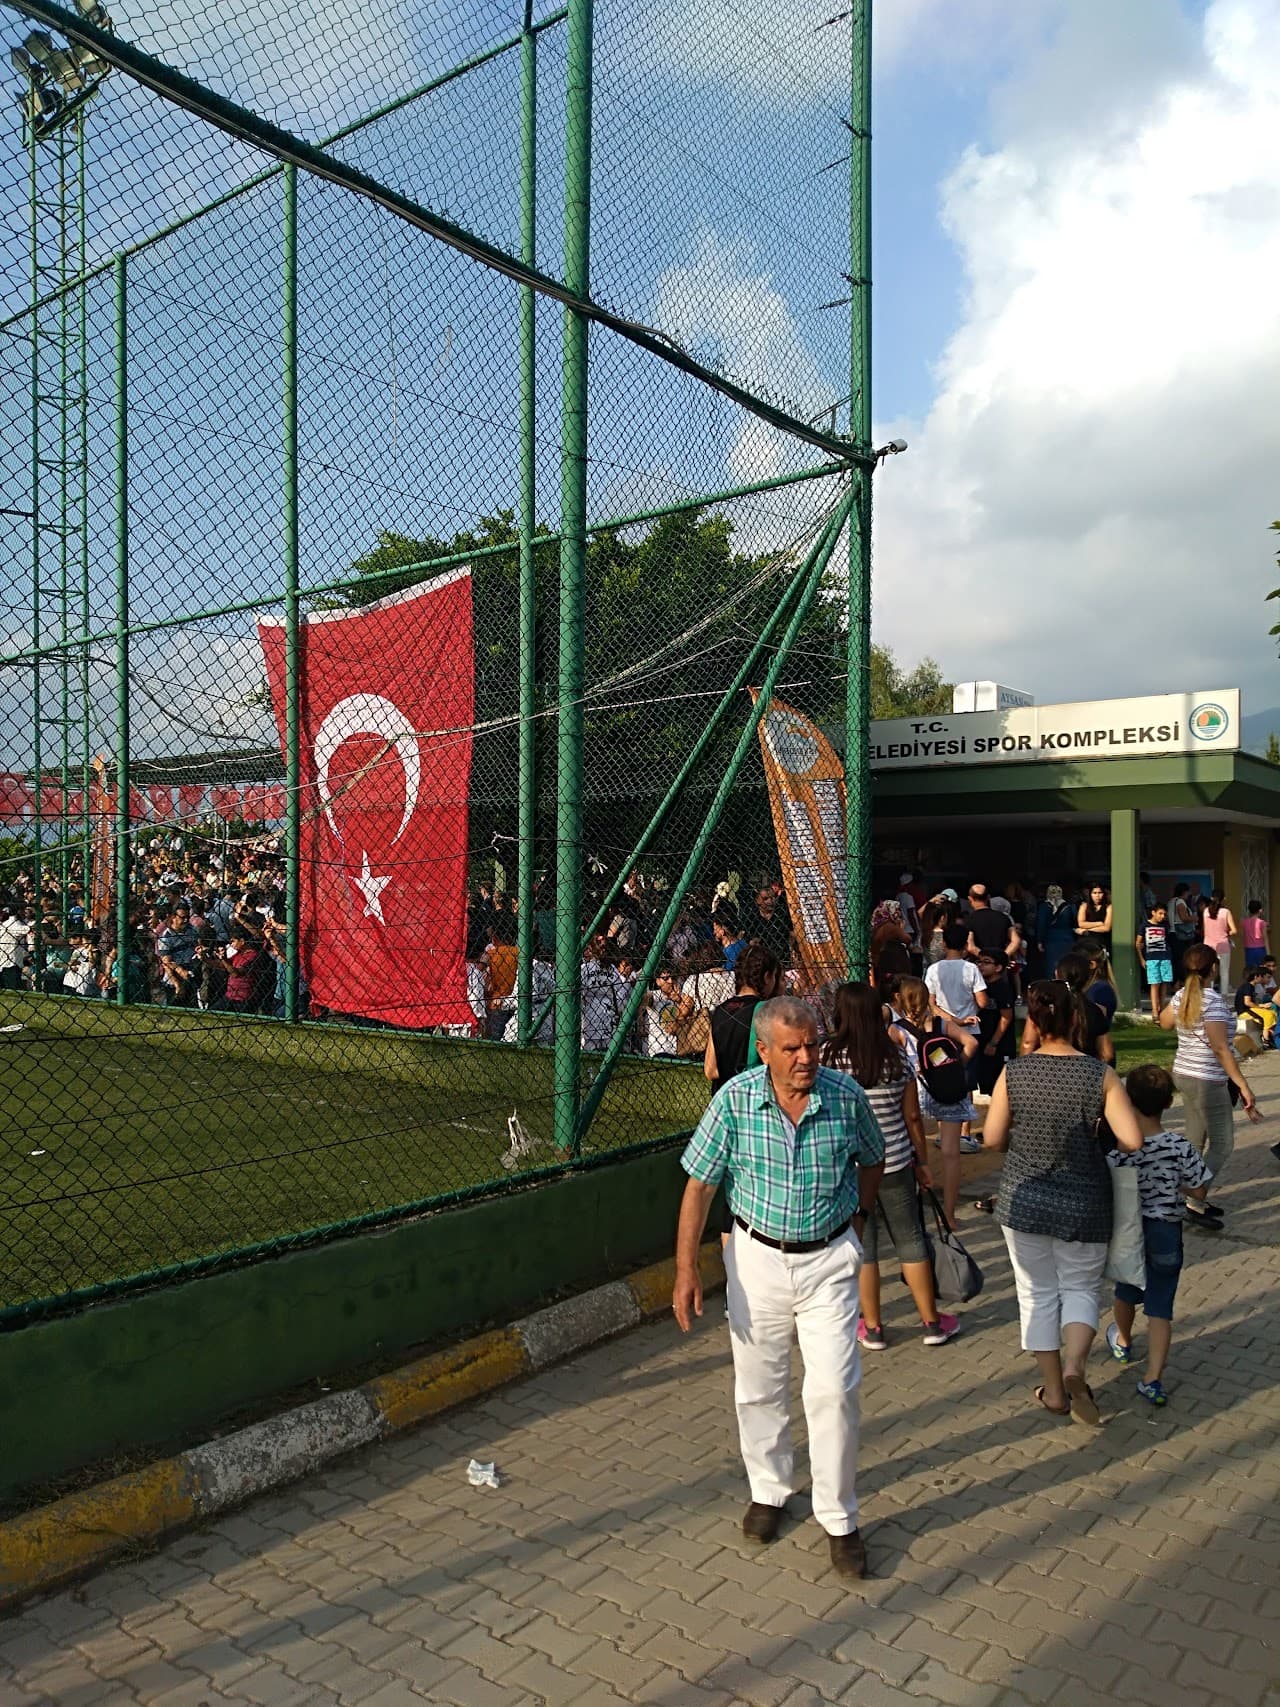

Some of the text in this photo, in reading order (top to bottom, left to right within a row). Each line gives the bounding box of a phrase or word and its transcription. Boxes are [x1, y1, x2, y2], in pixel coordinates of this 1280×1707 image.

[868, 736, 966, 759] ELEDİYESİ
[973, 735, 1032, 753] SPOR
[1040, 721, 1180, 749] KOMPLEKSİ
[910, 721, 949, 734] T.C.
